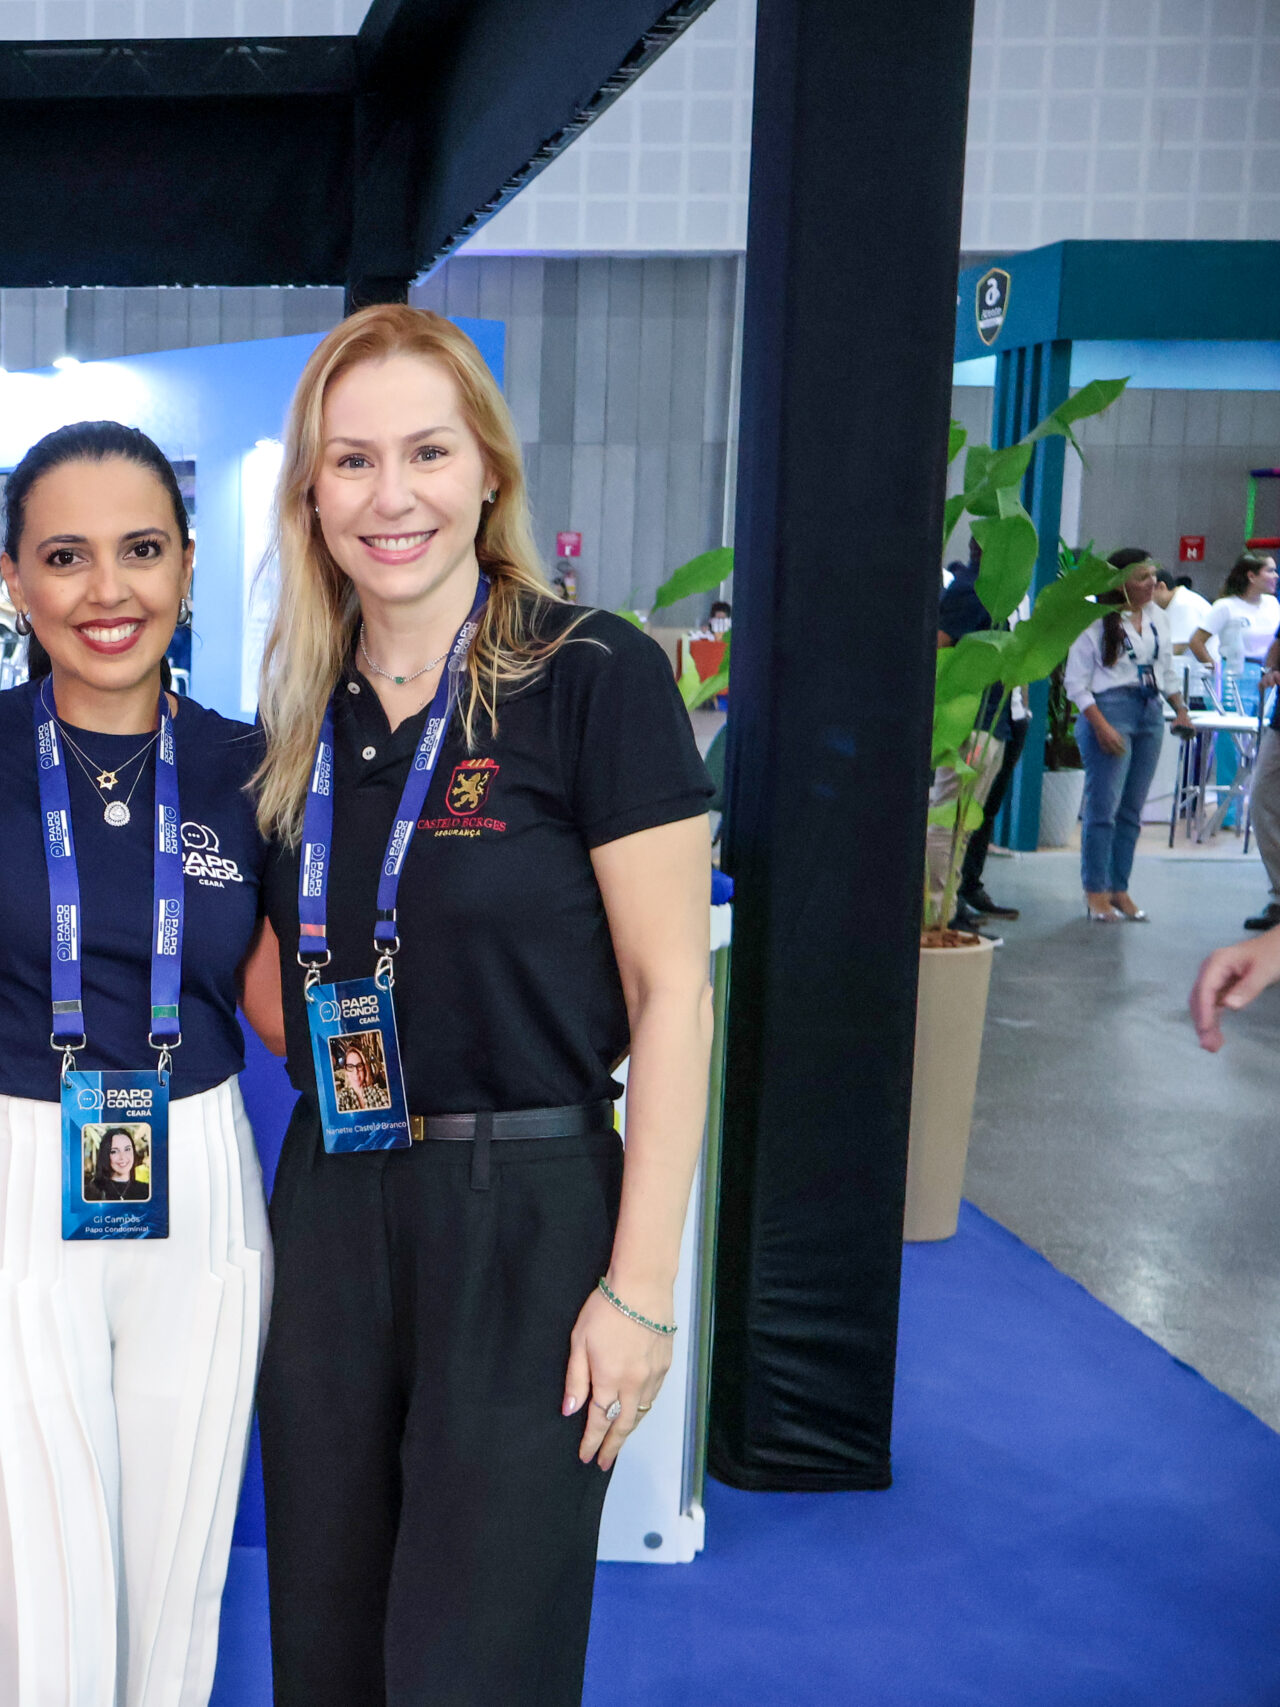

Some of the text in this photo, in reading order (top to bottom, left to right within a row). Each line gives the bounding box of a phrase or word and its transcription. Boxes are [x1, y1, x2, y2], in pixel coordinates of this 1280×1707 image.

[453, 621, 471, 654] PAPO
[37, 724, 47, 754] PAPO
[43, 722, 52, 752] CONDO
[419, 718, 436, 752] PAPO
[322, 763, 331, 796] PAPO
[46, 812, 57, 842] PAPO
[53, 811, 63, 841] CONDO
[170, 823, 178, 855] PAPO
[389, 821, 404, 856] PAPO
[462, 817, 507, 832] BORGES
[182, 852, 238, 873] APO
[183, 865, 243, 882] ONDO
[308, 861, 317, 897] CONDO
[314, 861, 324, 897] PAPO
[56, 904, 64, 942] PAPO
[163, 918, 172, 956] CONDO
[169, 918, 179, 956] PAPO
[341, 995, 378, 1009] PAPO
[343, 1005, 380, 1018] CONDO
[107, 1089, 153, 1099] PAPO
[107, 1099, 153, 1108] CONDO
[126, 1109, 152, 1117] CEARÁ
[354, 1122, 380, 1133] Castelo
[381, 1121, 407, 1130] Branco
[85, 1226, 103, 1234] Papo
[104, 1215, 141, 1225] Campos
